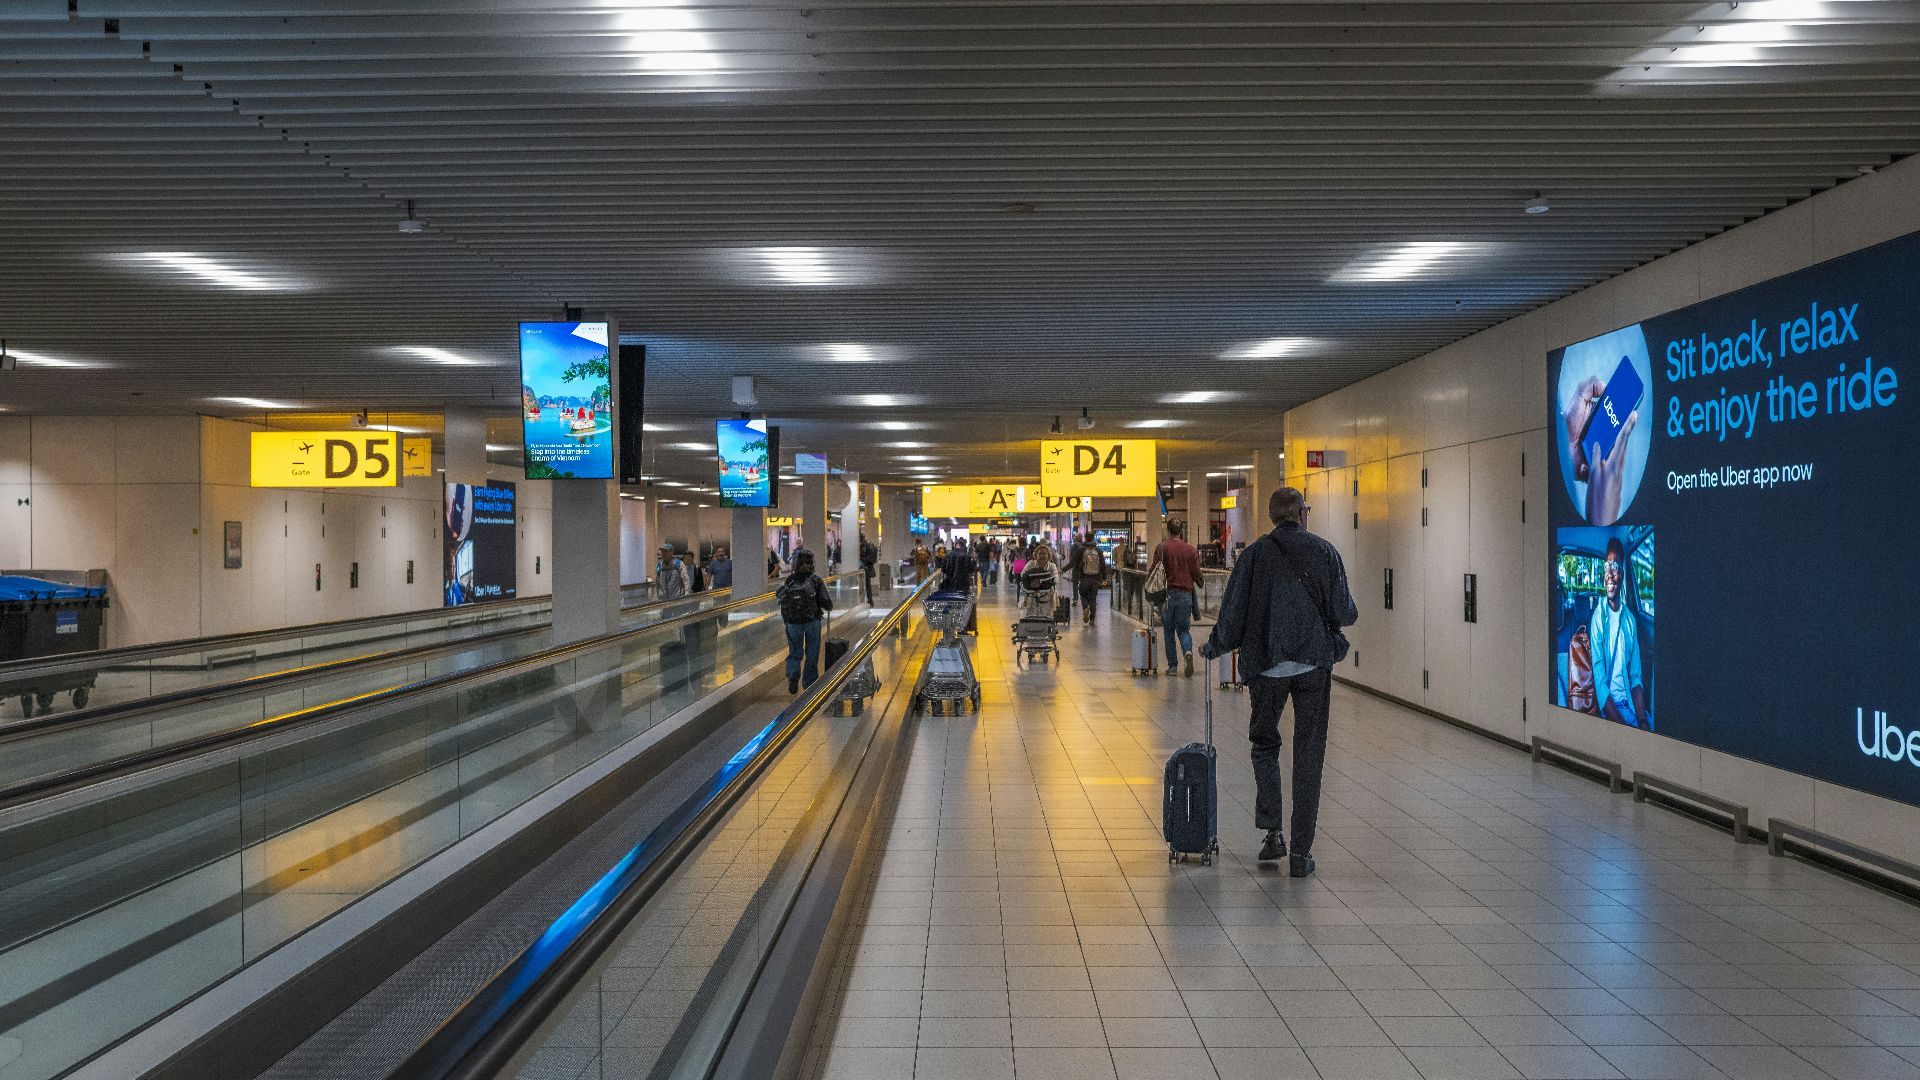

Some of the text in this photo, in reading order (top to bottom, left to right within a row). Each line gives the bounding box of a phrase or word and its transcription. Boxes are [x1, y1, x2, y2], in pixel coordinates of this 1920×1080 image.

[1666, 301, 1860, 382] Sit back, relax
[1603, 395, 1620, 428] Uber
[1666, 356, 1898, 442] & enjoy the ride
[325, 438, 390, 479] D5
[1073, 444, 1127, 476] D4
[1667, 463, 1813, 495] Open the Uber app now
